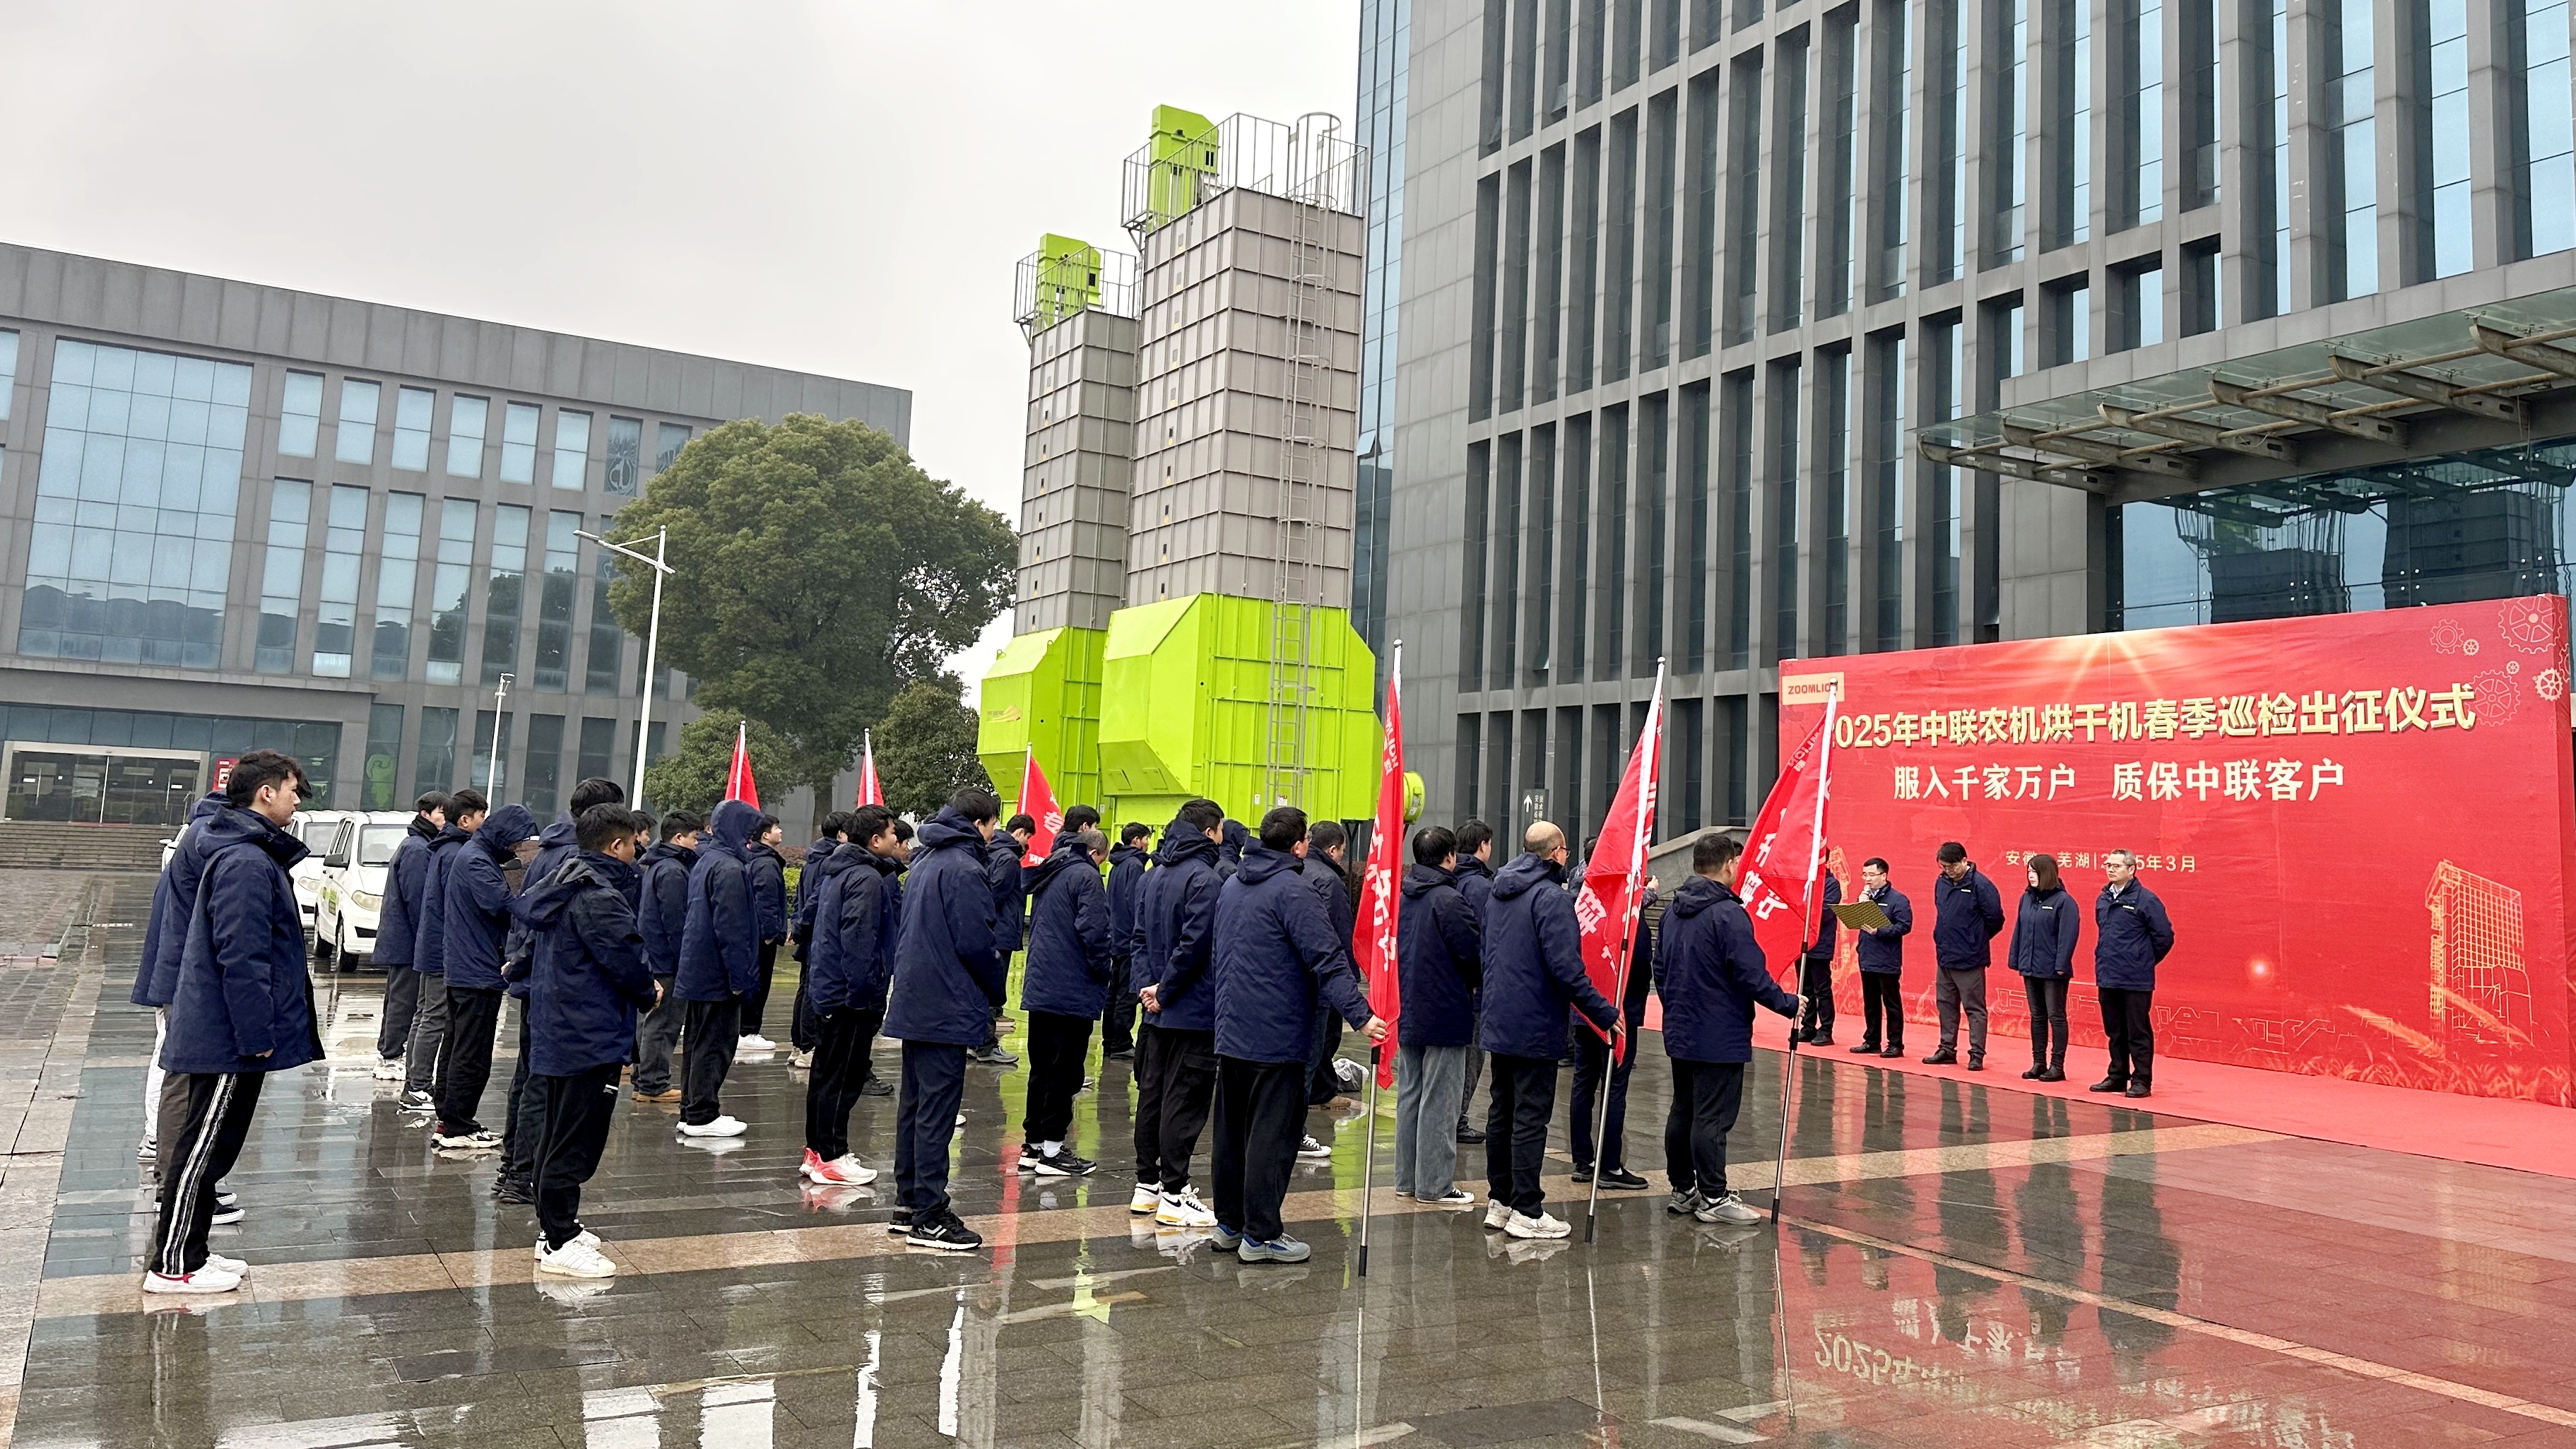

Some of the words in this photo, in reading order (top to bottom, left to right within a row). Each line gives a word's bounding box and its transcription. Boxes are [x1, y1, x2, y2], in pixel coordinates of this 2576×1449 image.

[1788, 682, 1838, 695] ZOOMLIO
[1831, 682, 2476, 749] 025年中联农机烘干机春季巡检出征仪式
[1893, 762, 2076, 802] 服入千家万户
[2111, 757, 2345, 802] 质保中联客户
